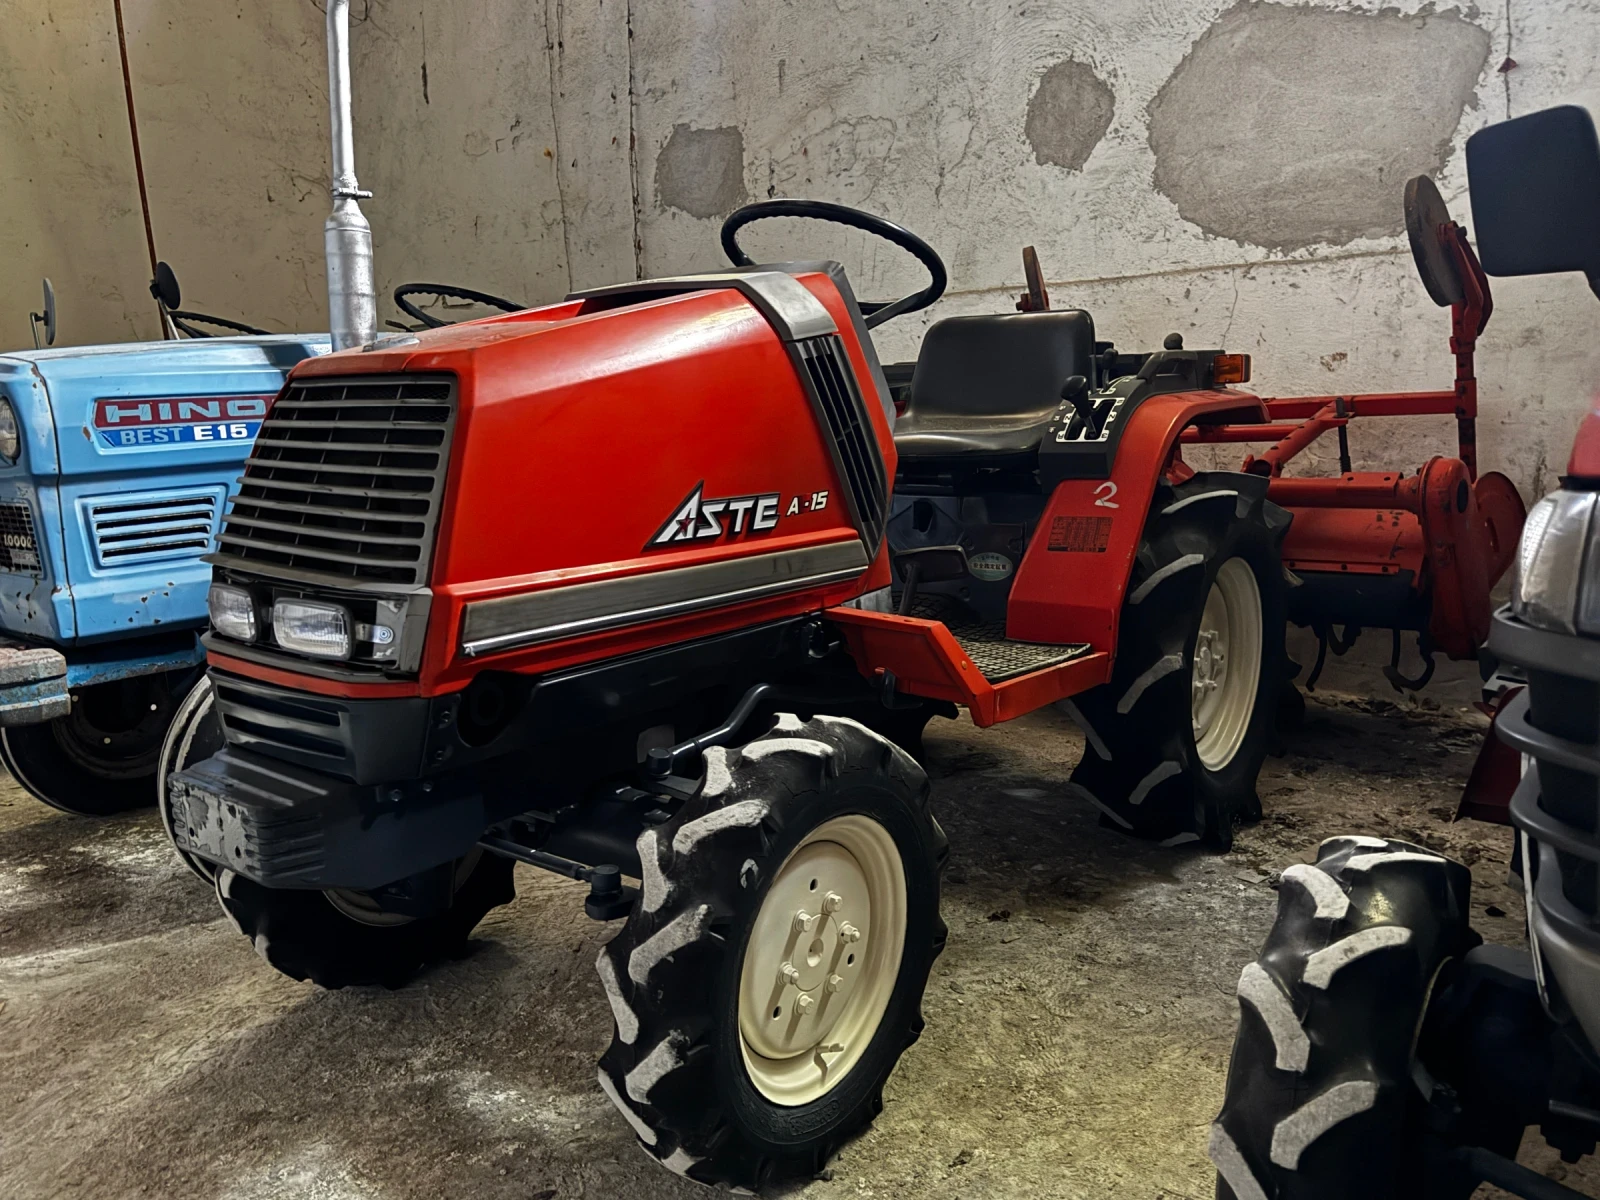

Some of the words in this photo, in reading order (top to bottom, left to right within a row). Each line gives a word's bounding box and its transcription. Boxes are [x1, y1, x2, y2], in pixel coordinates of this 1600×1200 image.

[105, 400, 267, 423] HINO
[120, 428, 184, 445] BEST
[193, 423, 248, 441] E15
[1093, 481, 1119, 508] 2
[646, 480, 780, 547] ASTE
